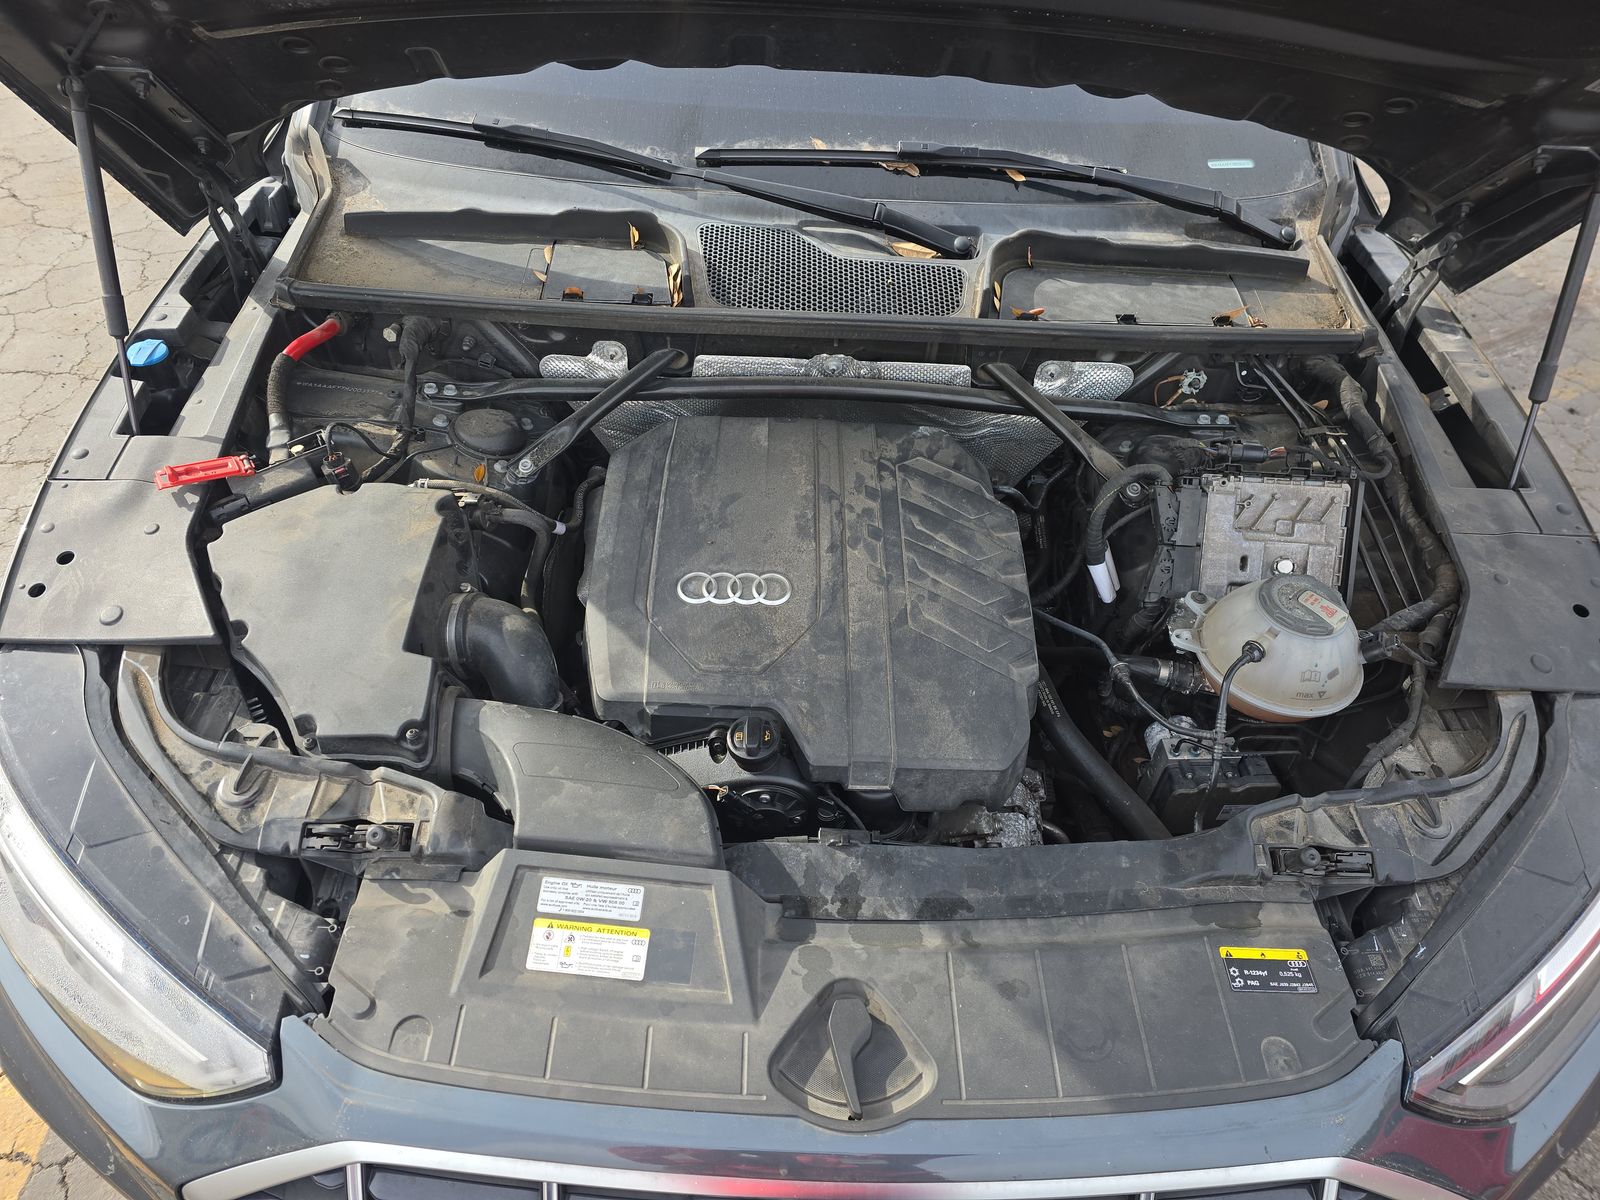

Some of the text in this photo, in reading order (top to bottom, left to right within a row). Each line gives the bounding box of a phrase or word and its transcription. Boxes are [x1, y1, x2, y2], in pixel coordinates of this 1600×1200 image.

[1296, 691, 1313, 699] max
[556, 923, 638, 937] WARNING ATTENTION
[1243, 969, 1268, 977] R-1234yf
